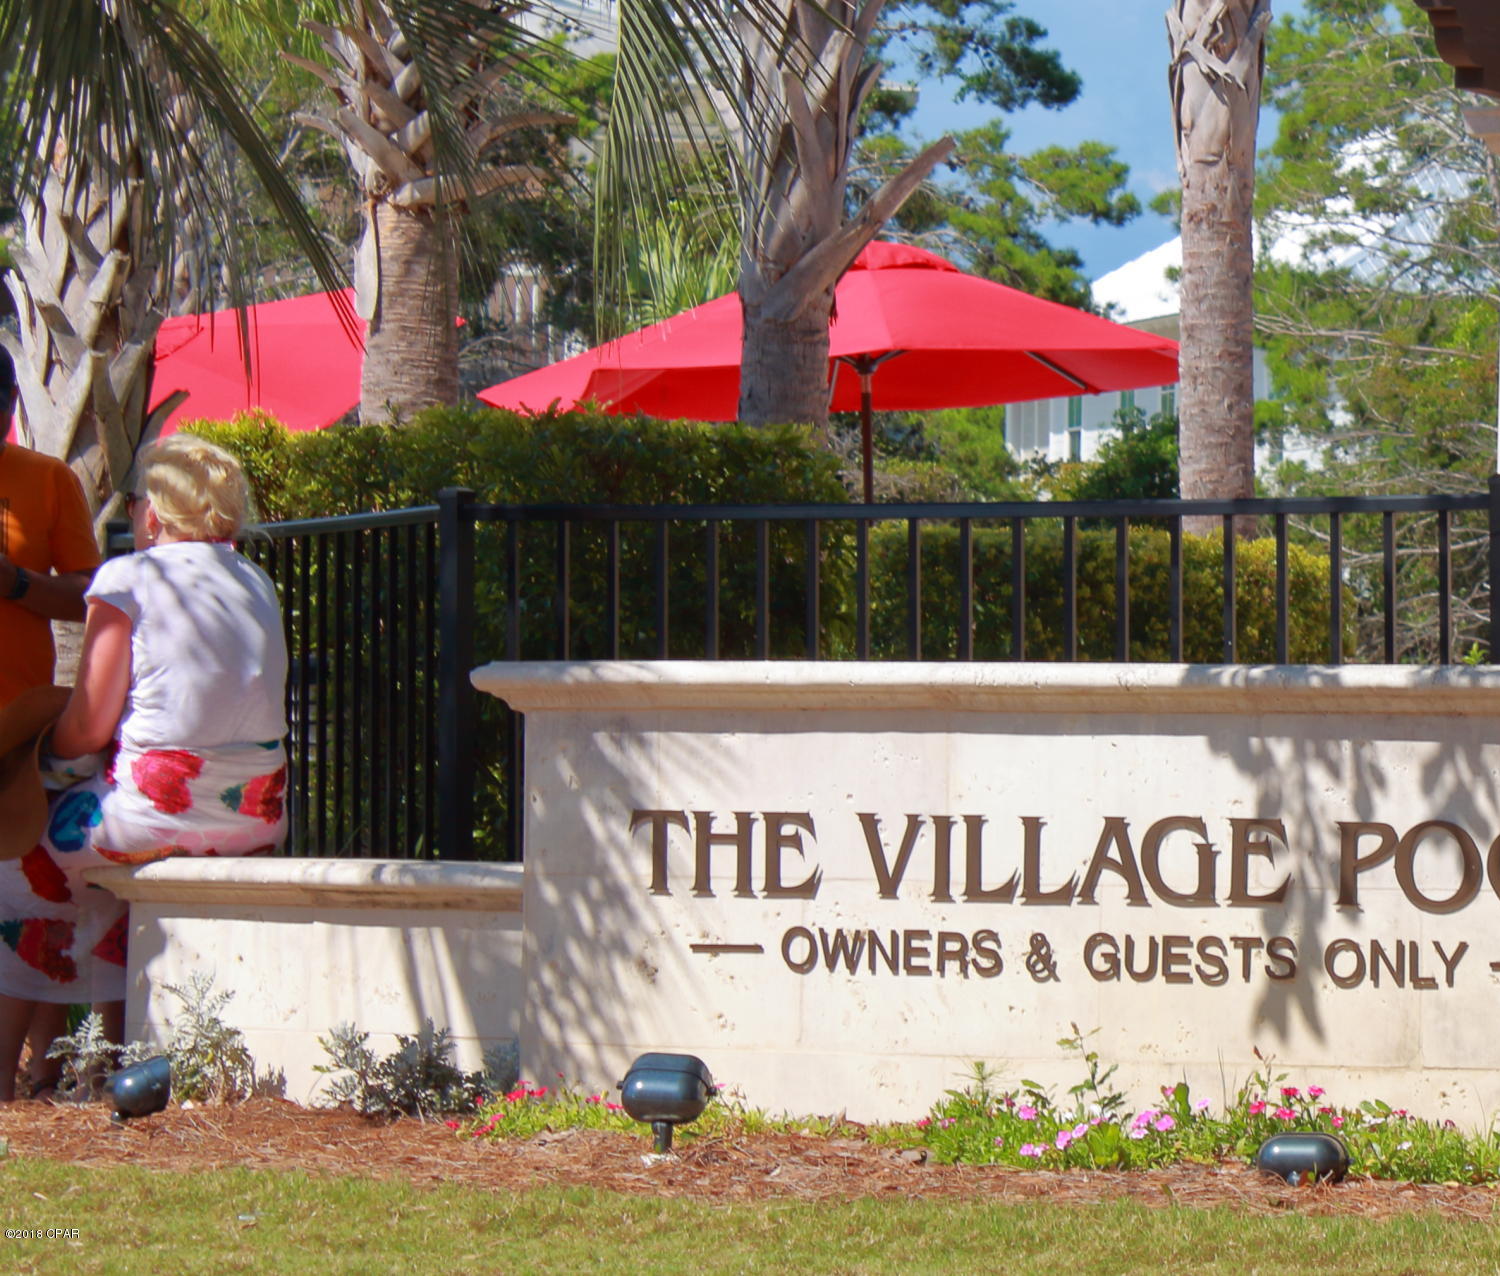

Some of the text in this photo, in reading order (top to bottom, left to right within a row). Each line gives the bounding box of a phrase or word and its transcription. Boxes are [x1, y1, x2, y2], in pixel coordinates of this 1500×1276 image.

[629, 809, 823, 900] THE
[855, 812, 1295, 908] VILLAGE
[781, 925, 1469, 990] OWNERS & GUESTS ONLY
